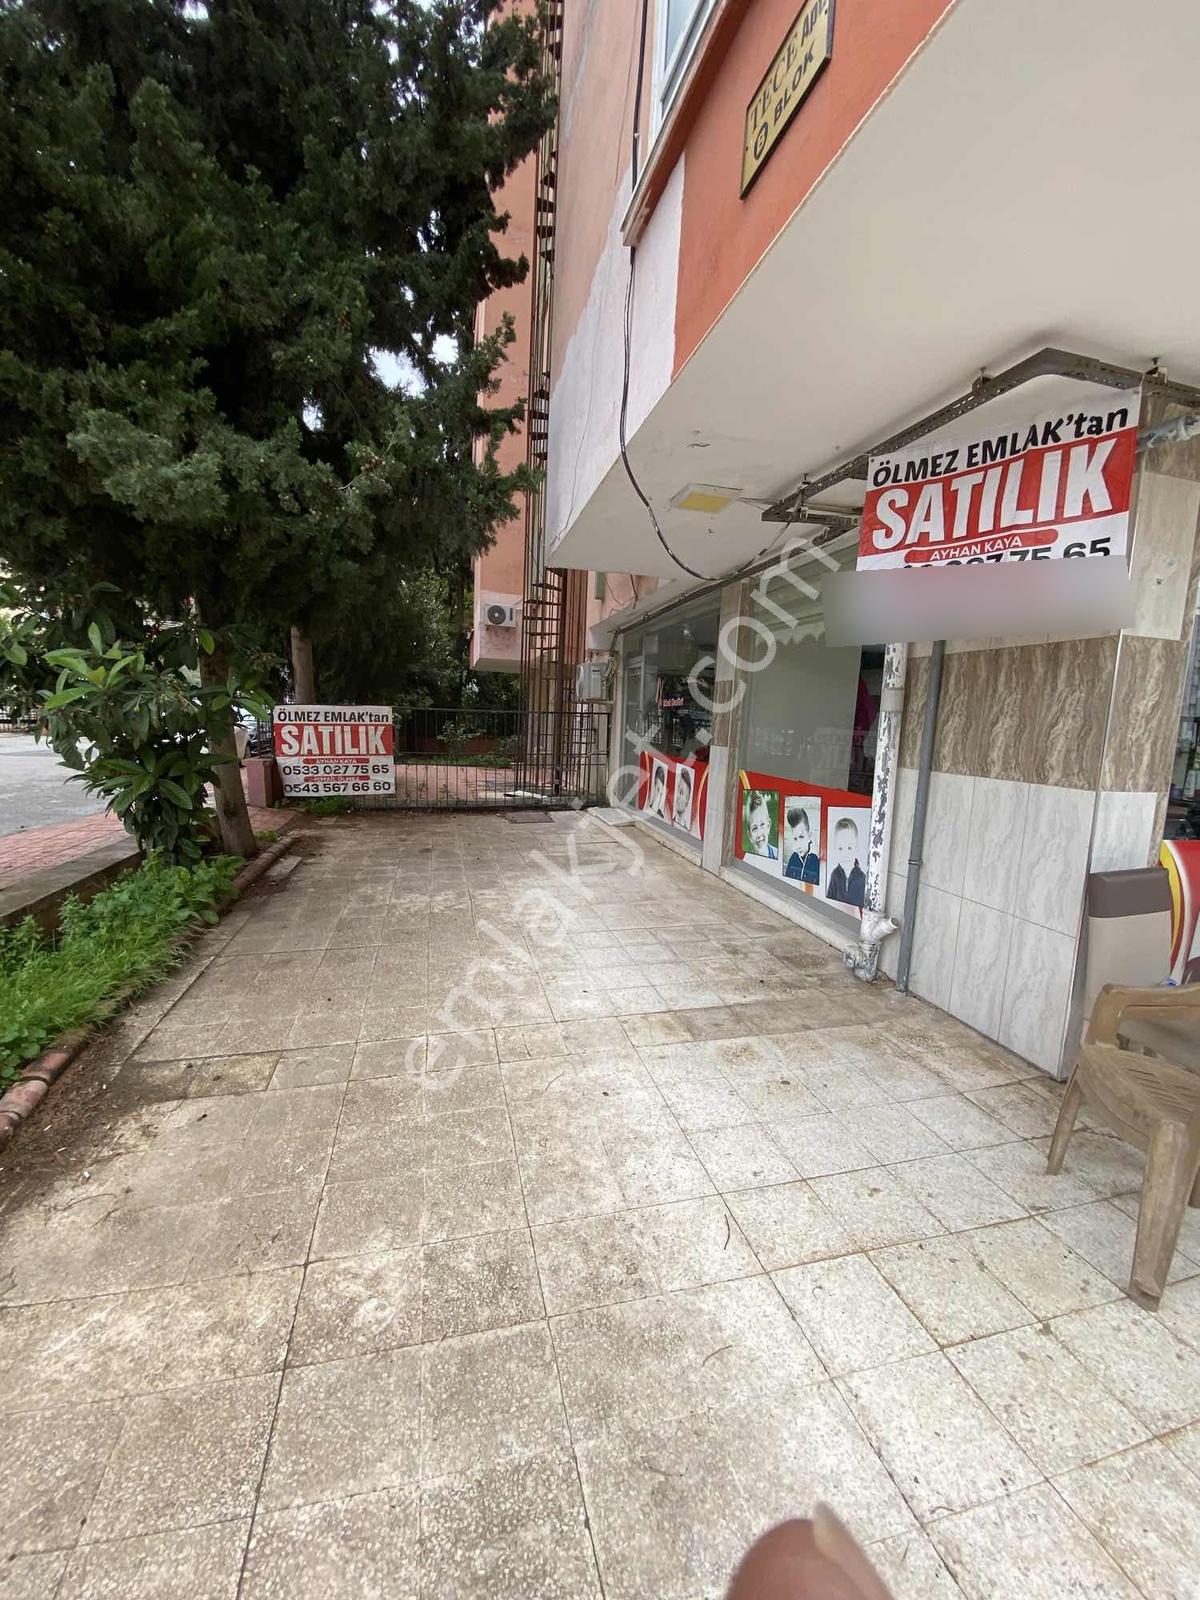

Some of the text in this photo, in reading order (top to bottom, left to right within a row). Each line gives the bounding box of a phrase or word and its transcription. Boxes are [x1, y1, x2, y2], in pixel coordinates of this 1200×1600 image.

[751, 32, 798, 133] TECE
[774, 38, 815, 126] BLOK
[872, 449, 960, 488] ÖLMEZ
[872, 438, 1118, 550] SATILIK
[929, 543, 981, 562] AYHAN
[984, 535, 1023, 556] KAYA
[278, 708, 321, 722] ÖLMEZ
[281, 725, 386, 756] SATILIK
[283, 764, 389, 775] 0533 027 75 65
[284, 781, 391, 793] 0543 567 66 60
